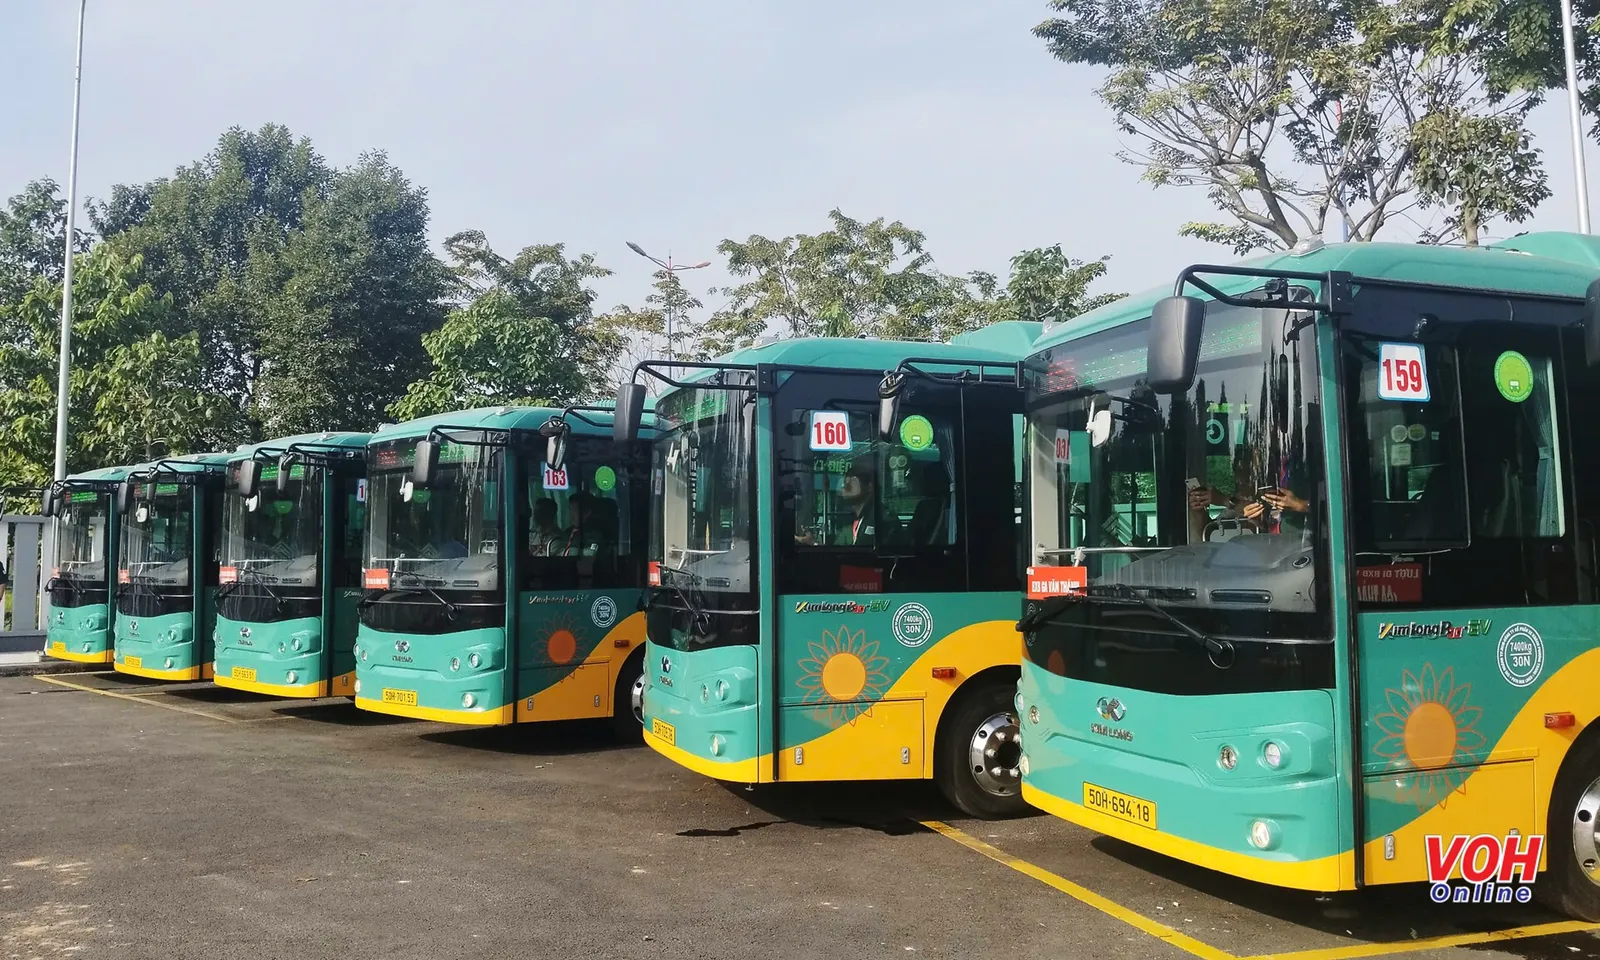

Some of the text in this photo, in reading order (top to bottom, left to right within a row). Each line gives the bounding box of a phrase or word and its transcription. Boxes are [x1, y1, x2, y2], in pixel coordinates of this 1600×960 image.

[1382, 359, 1423, 392] 159
[814, 421, 846, 445] 160
[545, 469, 566, 486] 163
[905, 625, 921, 634] 30N
[1510, 641, 1532, 654] 7400kg
[1512, 656, 1531, 667] 30N
